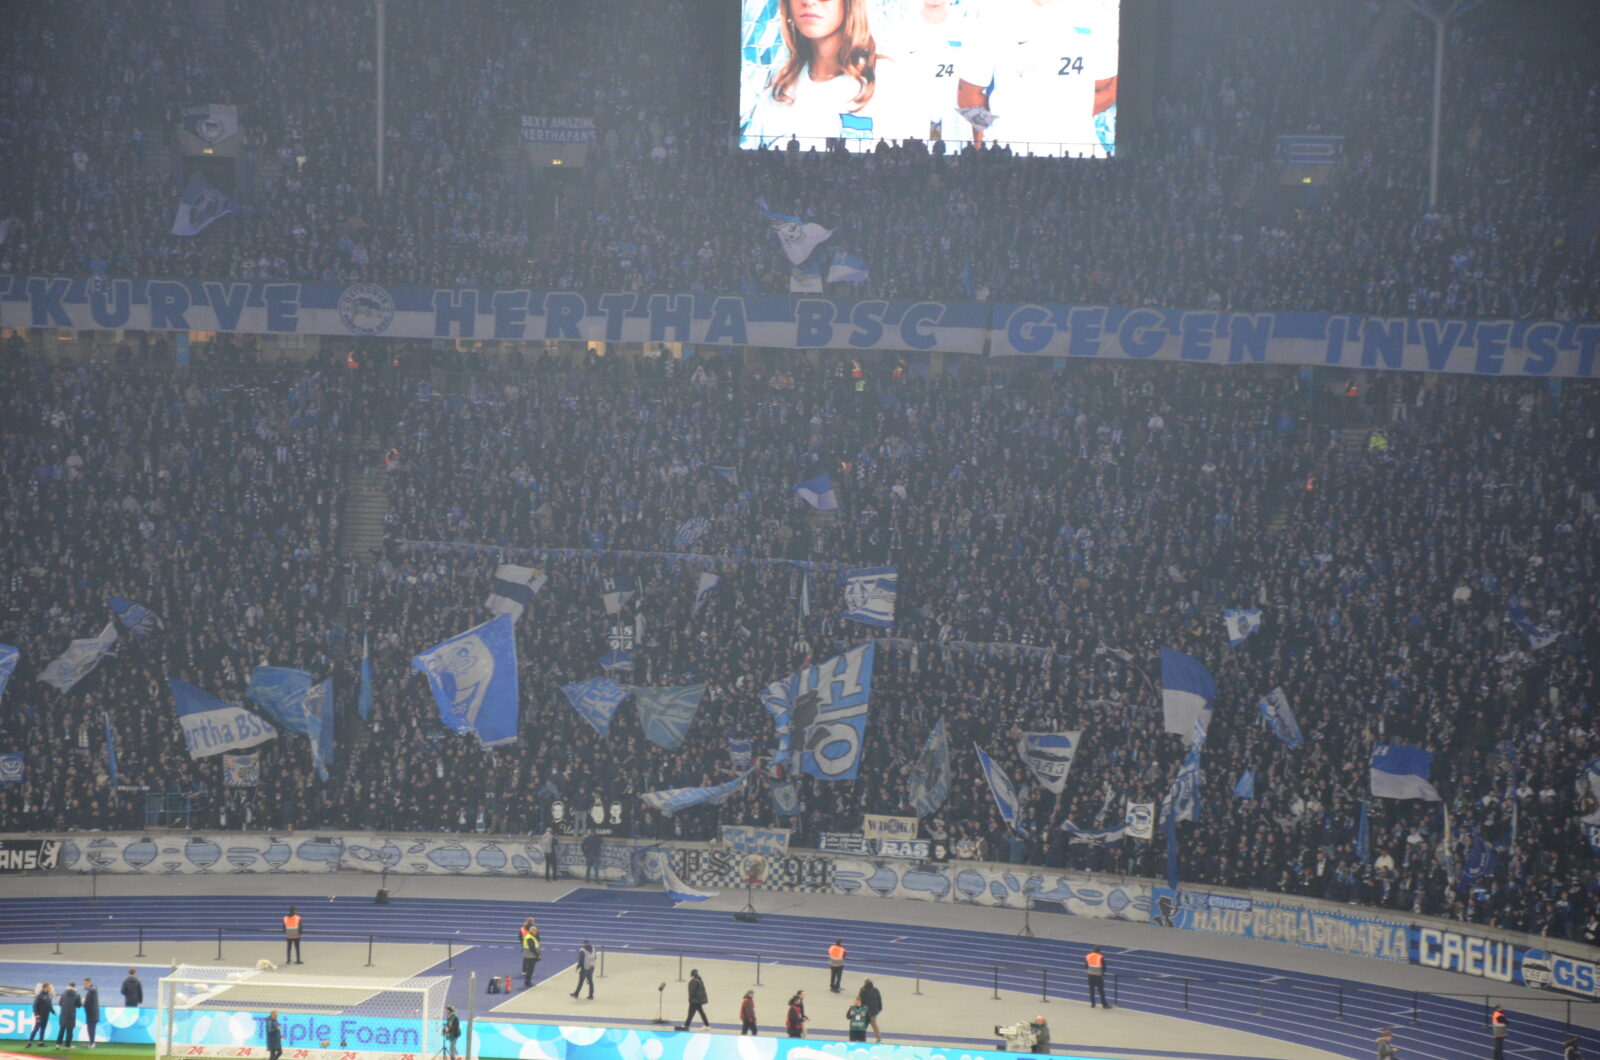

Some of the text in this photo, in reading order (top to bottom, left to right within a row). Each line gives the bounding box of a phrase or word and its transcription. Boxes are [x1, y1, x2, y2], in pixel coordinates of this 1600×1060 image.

[935, 64, 954, 78] 24
[1057, 56, 1085, 76] 24
[521, 116, 547, 127] SEXY
[431, 289, 748, 344] HERTHA
[794, 298, 946, 349] BSC
[1005, 302, 1275, 365] GEGEN
[1323, 315, 1600, 377] INVEST
[1419, 928, 1514, 982] CREW
[252, 1016, 419, 1047] Tiple Foam
